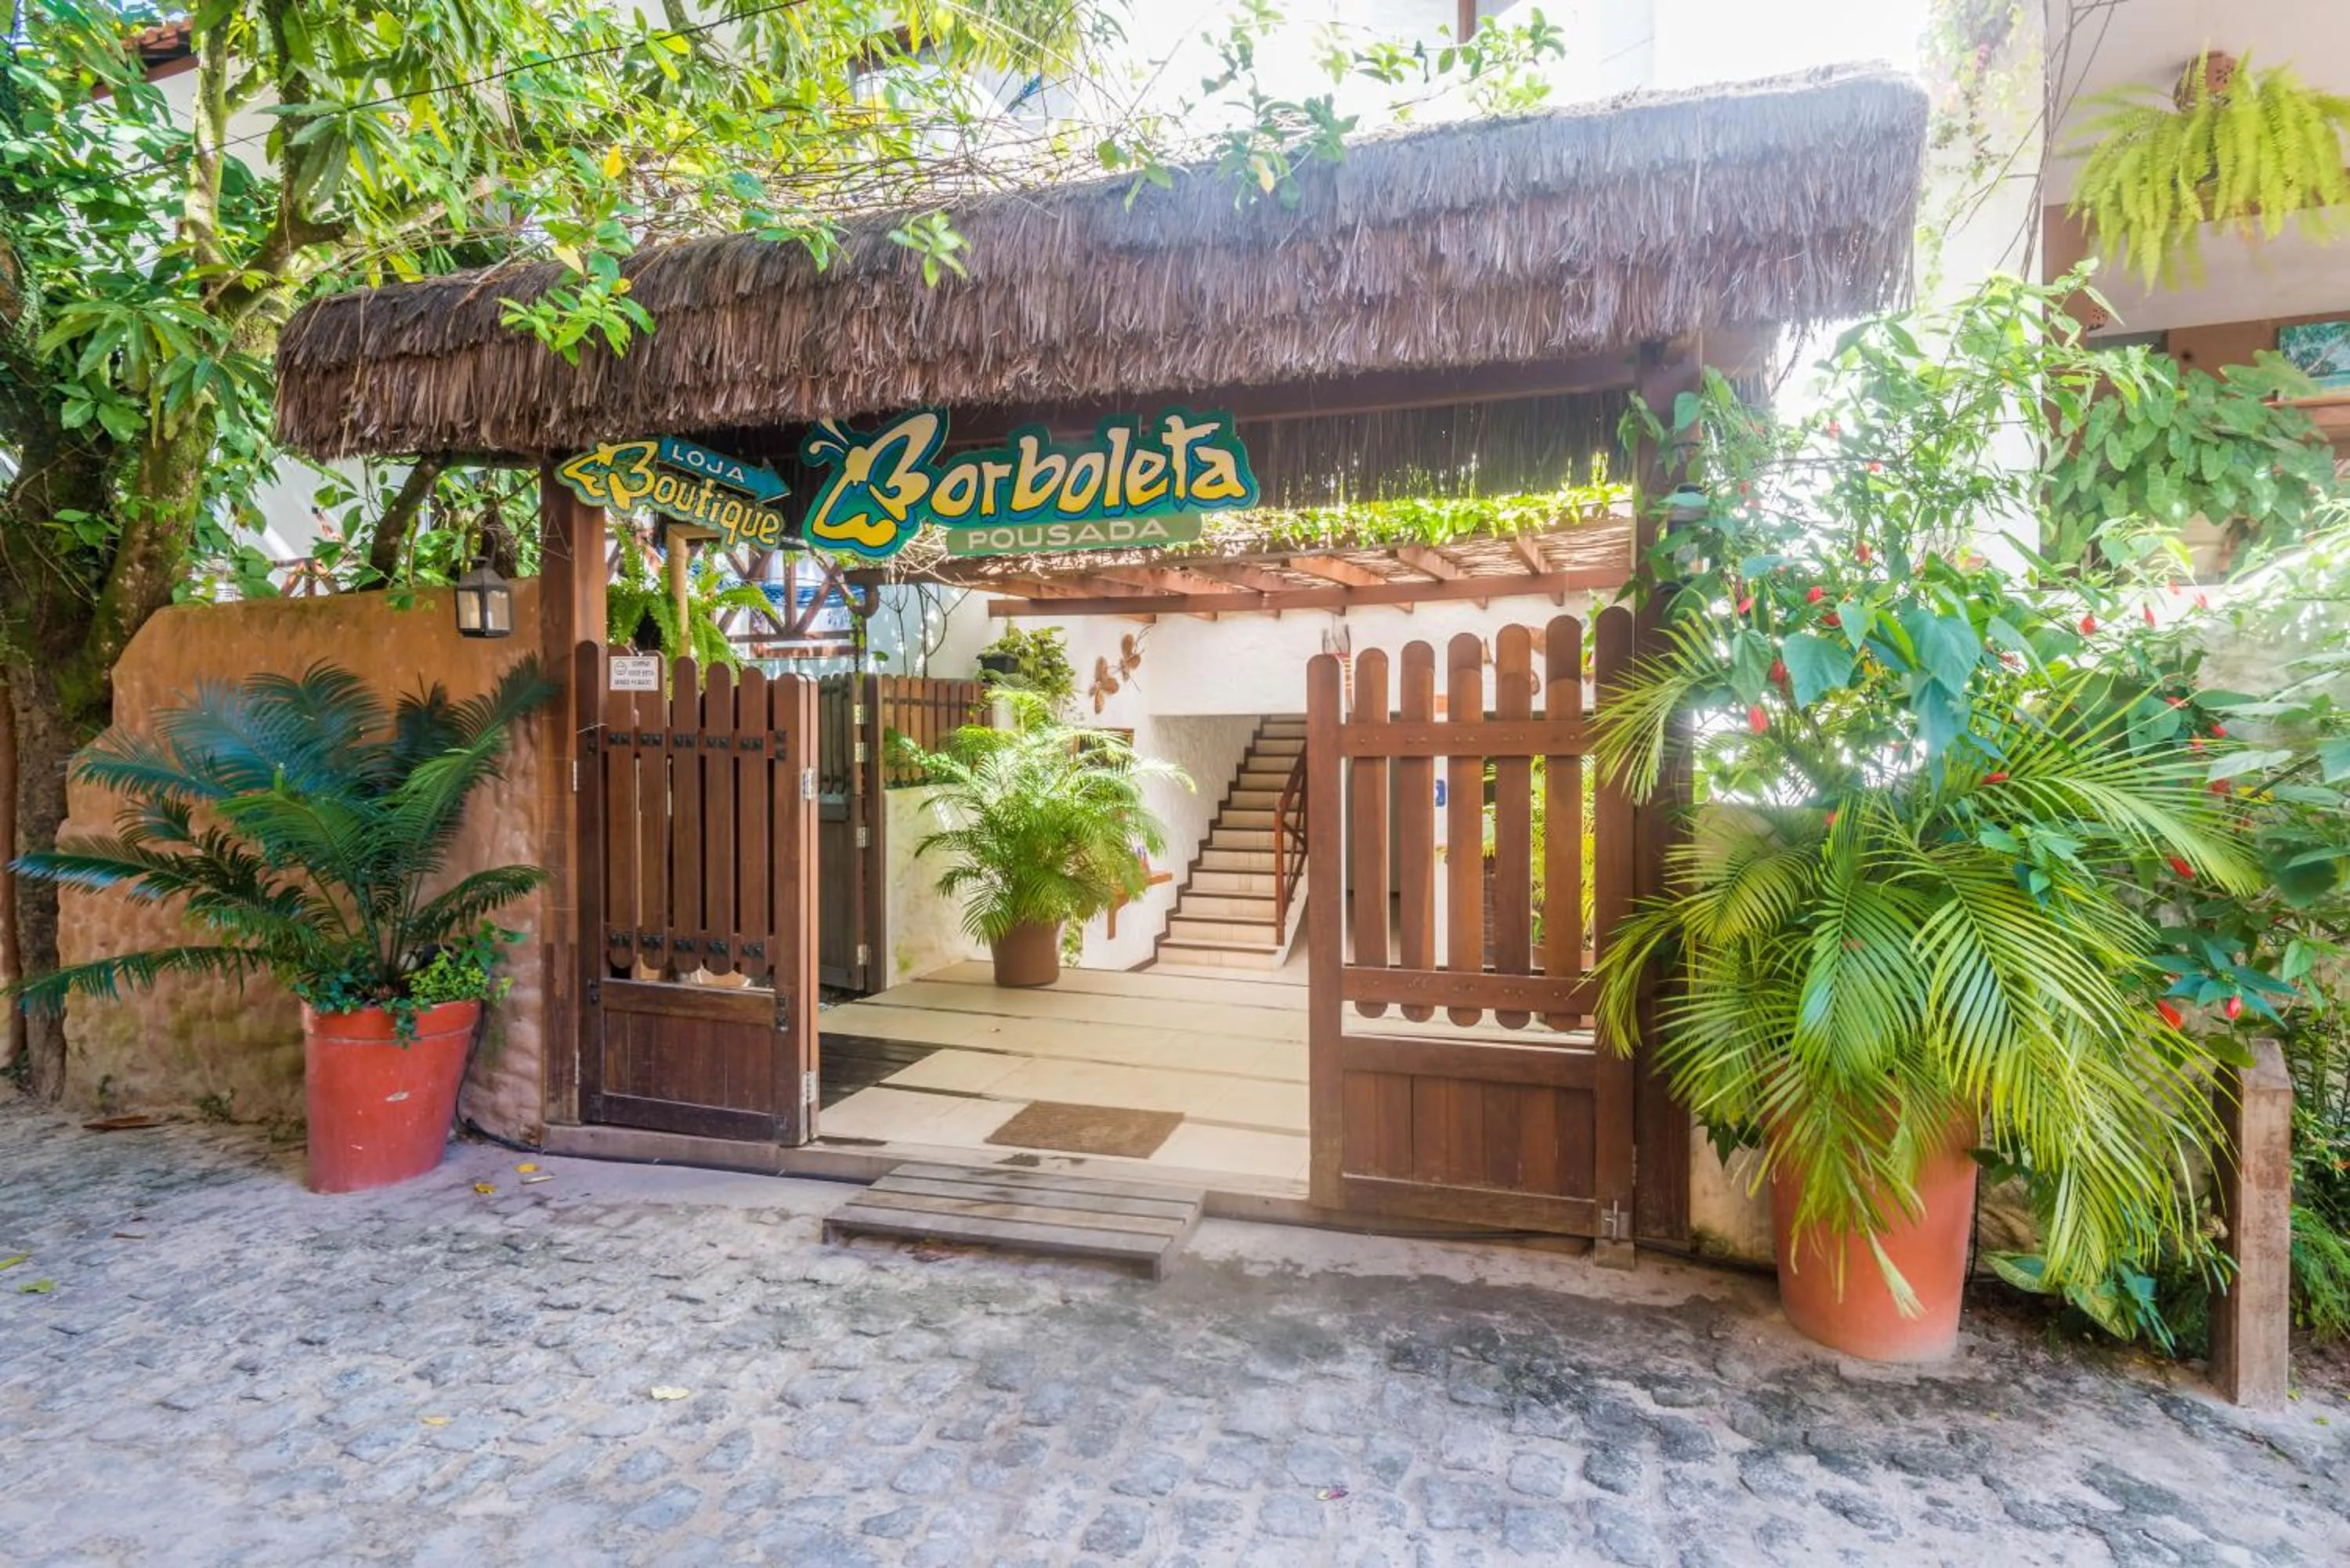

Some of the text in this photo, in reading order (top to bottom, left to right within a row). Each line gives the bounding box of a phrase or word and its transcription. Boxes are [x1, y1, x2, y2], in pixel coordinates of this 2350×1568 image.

[563, 441, 779, 546] Boutique
[671, 444, 745, 483] LOJA
[812, 413, 1246, 547] Borboleta
[968, 518, 1170, 550] POUSADA
